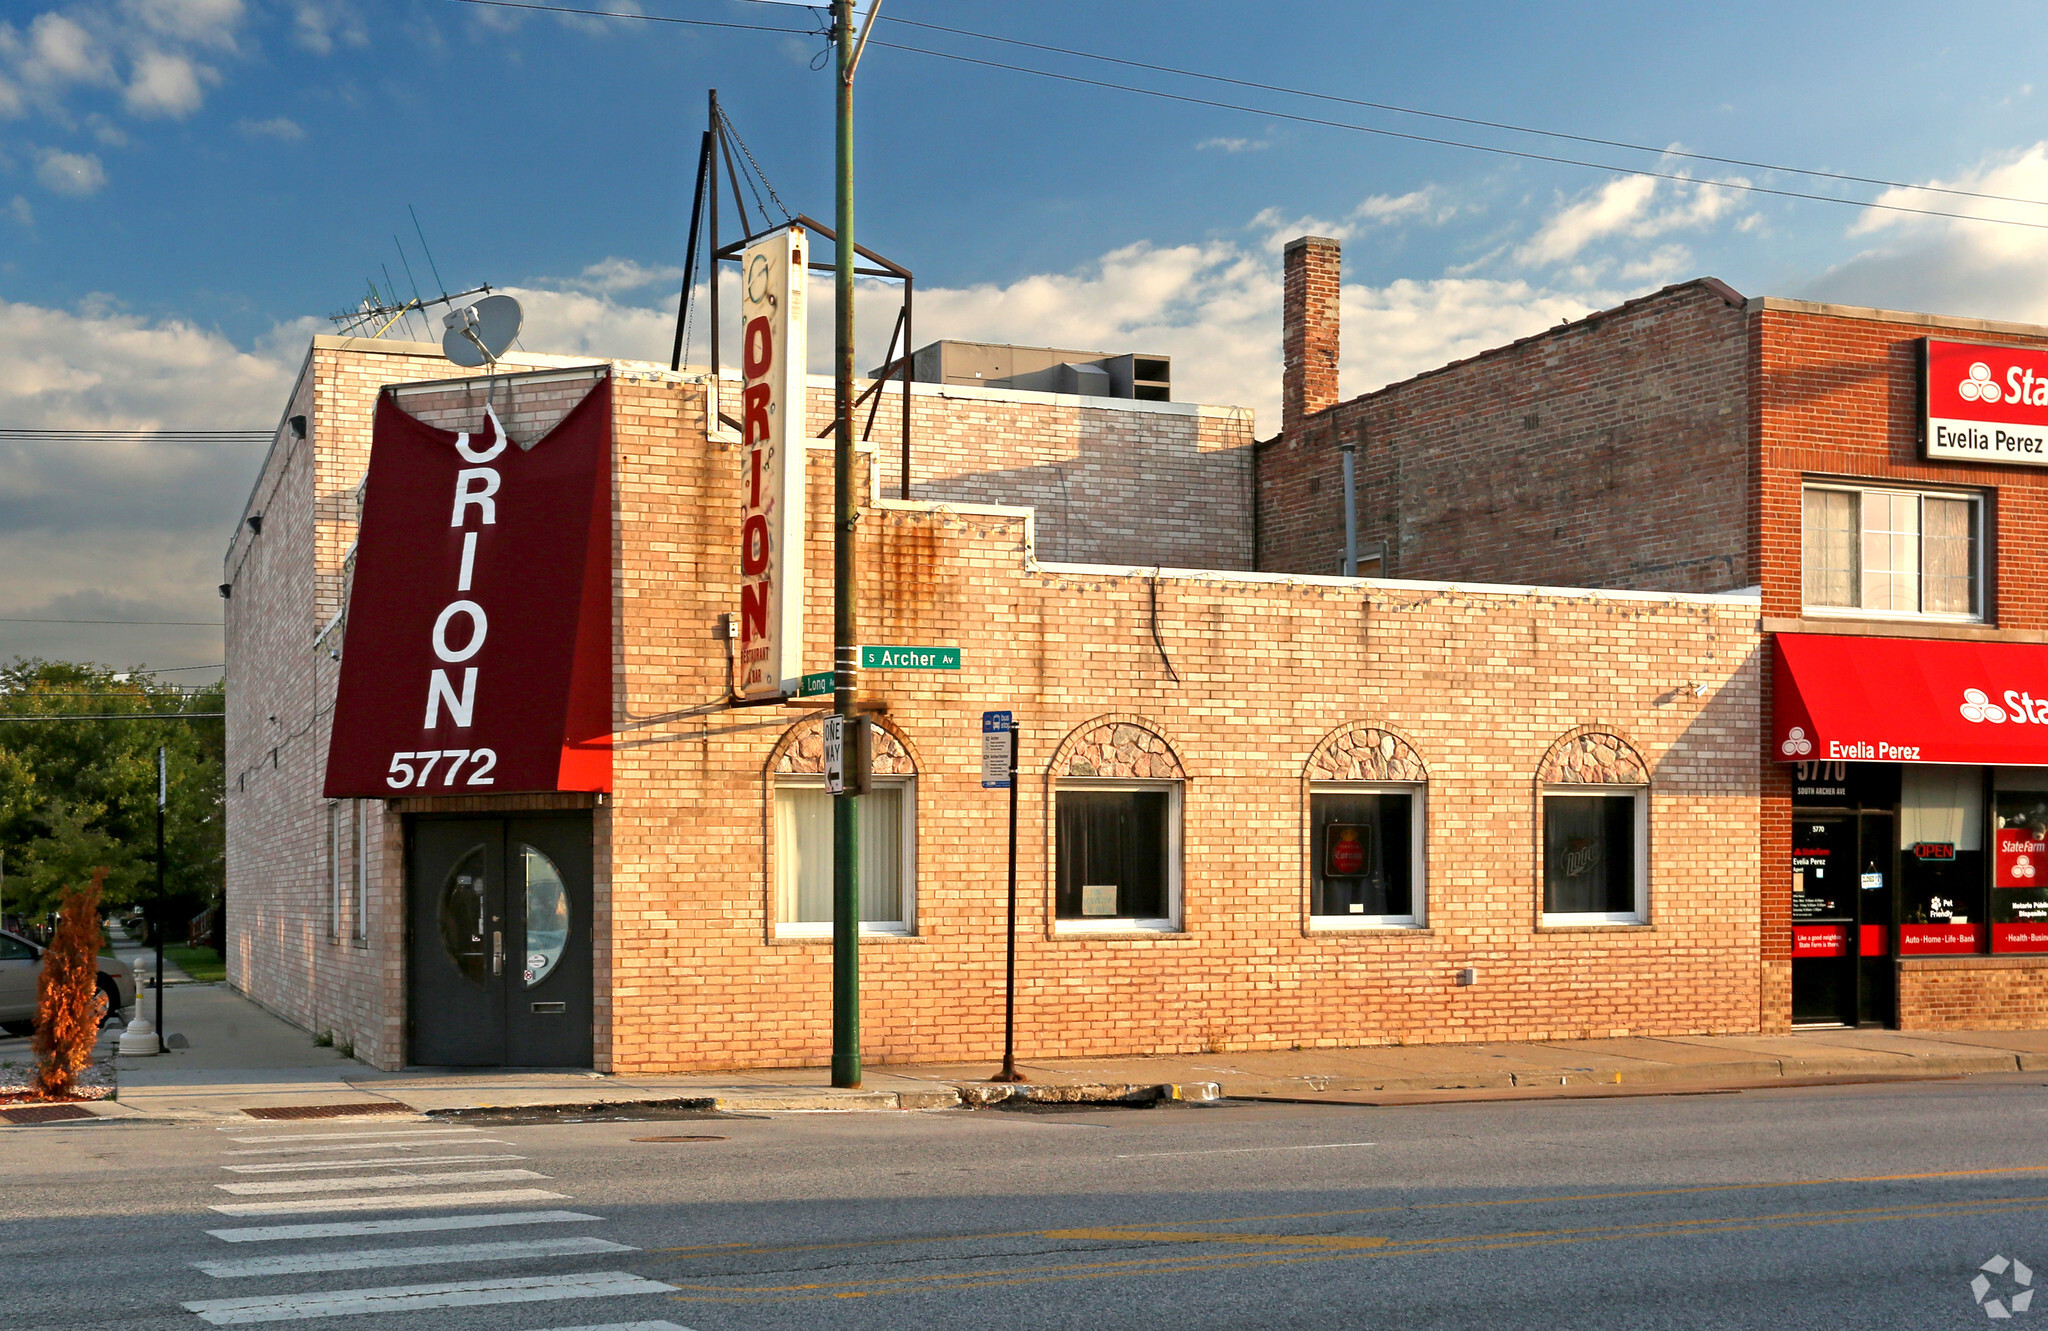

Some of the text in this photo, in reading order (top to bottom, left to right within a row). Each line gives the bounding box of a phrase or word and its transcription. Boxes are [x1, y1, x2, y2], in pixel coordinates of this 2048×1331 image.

[2005, 366, 2048, 406] Sta
[1937, 426, 2043, 453] Evelia Perez
[742, 316, 773, 643] ORION
[741, 647, 769, 664] RESTAURANT
[868, 650, 953, 666] S Archer Av
[807, 678, 826, 693] Long
[825, 722, 840, 741] ONE
[825, 744, 841, 763] WAY
[1829, 741, 1921, 760] Evelia Perez
[386, 748, 498, 789] 5772
[1797, 787, 1846, 795] SOUTH ARCHER AVE
[1915, 844, 1953, 858] OPEN
[1943, 899, 1953, 907] Pet
[1930, 909, 1953, 918] Friendly
[1905, 934, 1975, 944] Auto Home Life Bank
[2008, 933, 2028, 942] Health
